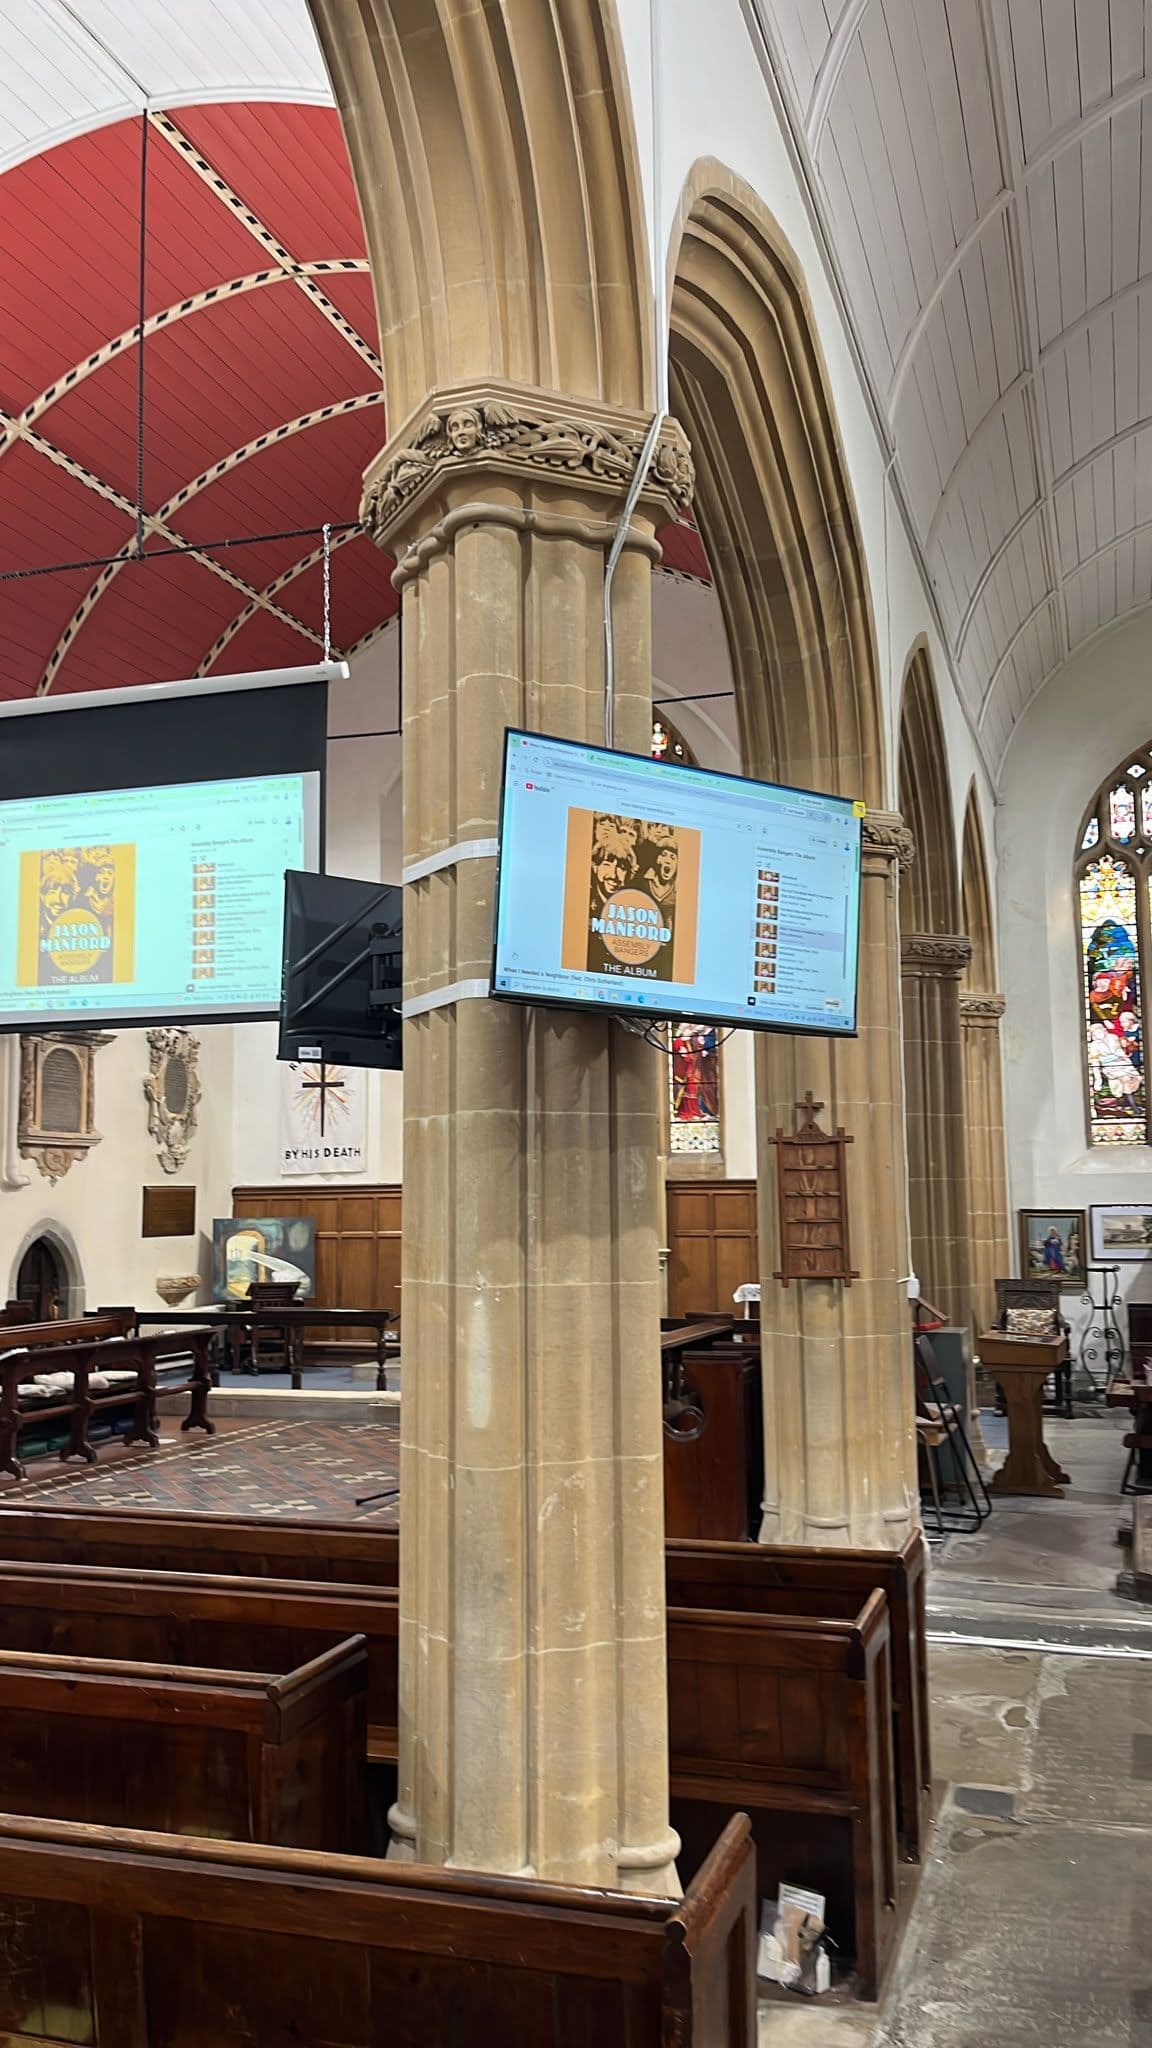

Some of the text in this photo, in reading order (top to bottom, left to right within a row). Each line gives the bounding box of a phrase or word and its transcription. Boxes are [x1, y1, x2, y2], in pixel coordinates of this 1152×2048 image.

[607, 903, 658, 924] JASON
[591, 917, 672, 943] MANFORD
[603, 963, 657, 978] THE ALBUM
[285, 1147, 361, 1160] BY HIS DEATH
